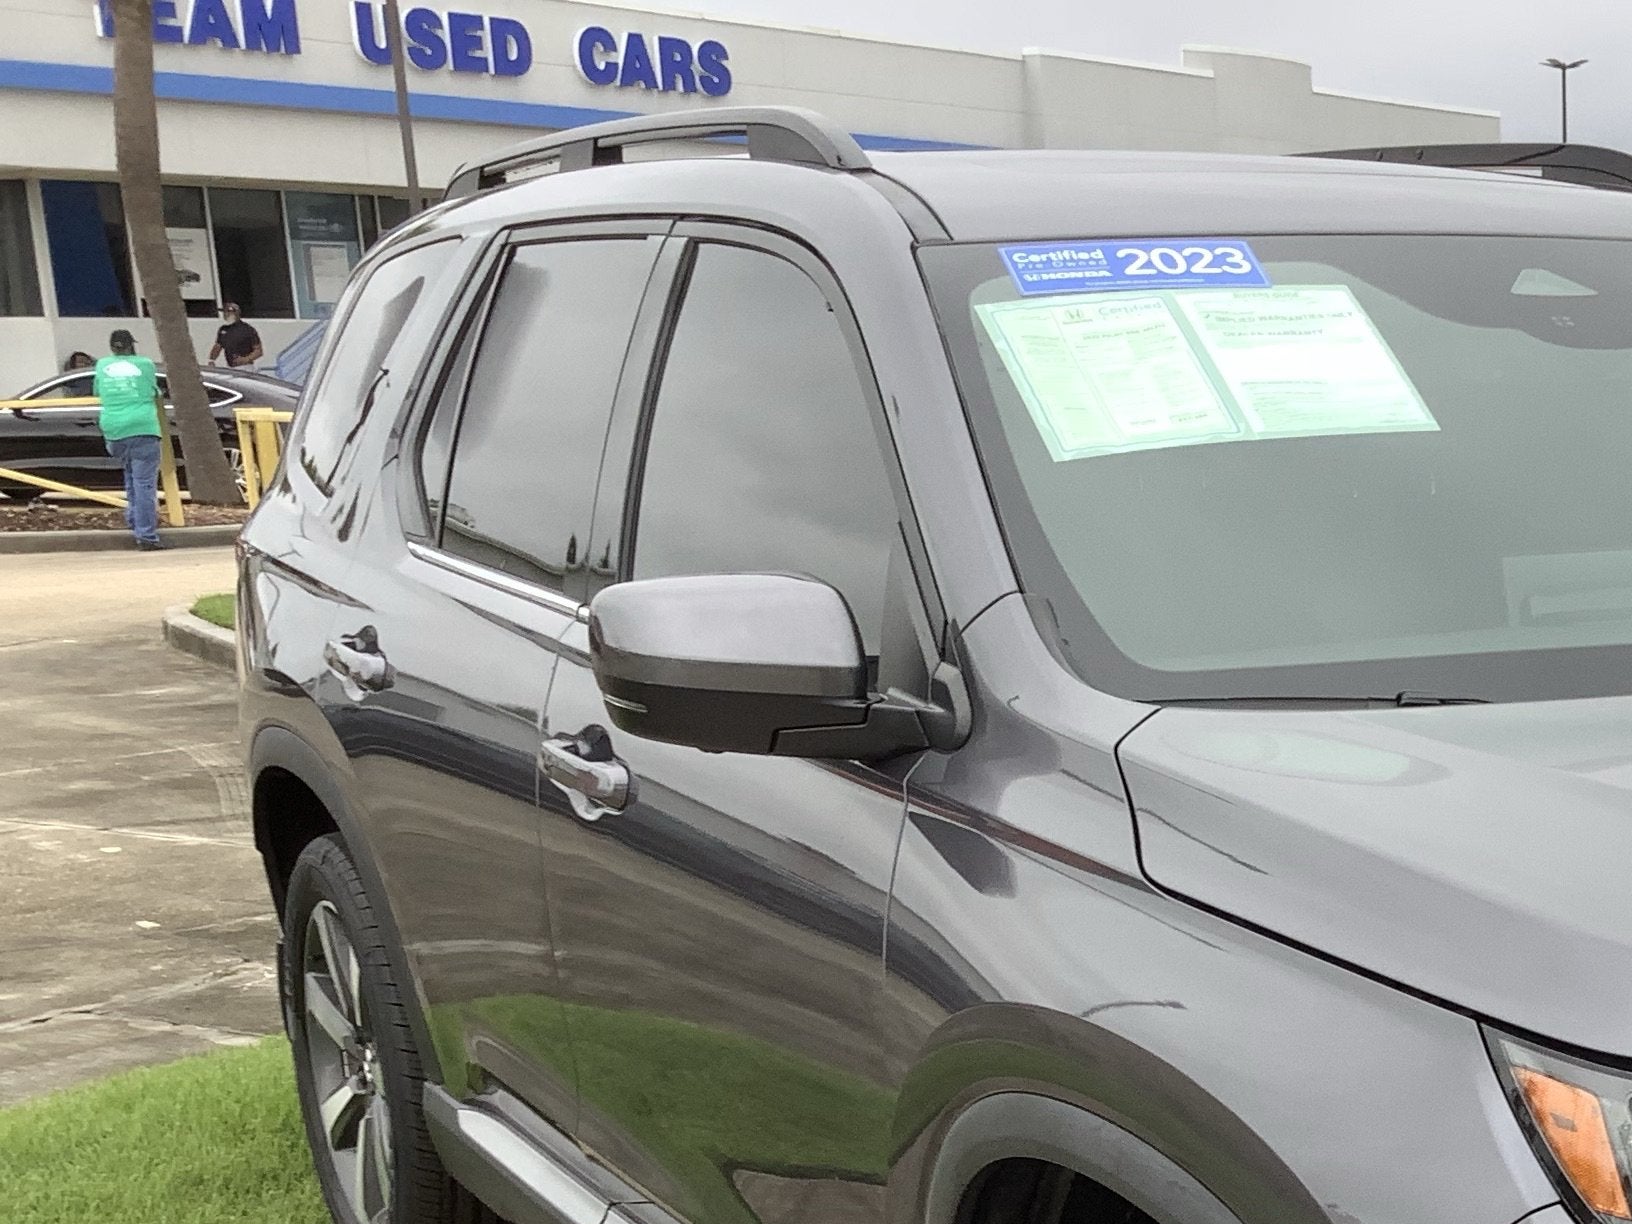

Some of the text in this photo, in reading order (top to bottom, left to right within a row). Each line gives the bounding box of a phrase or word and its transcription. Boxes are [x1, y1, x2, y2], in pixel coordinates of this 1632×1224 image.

[98, 0, 732, 97] EAM USED CARS
[1012, 247, 1252, 275] Certified 2023
[1041, 270, 1113, 280] HONDA
